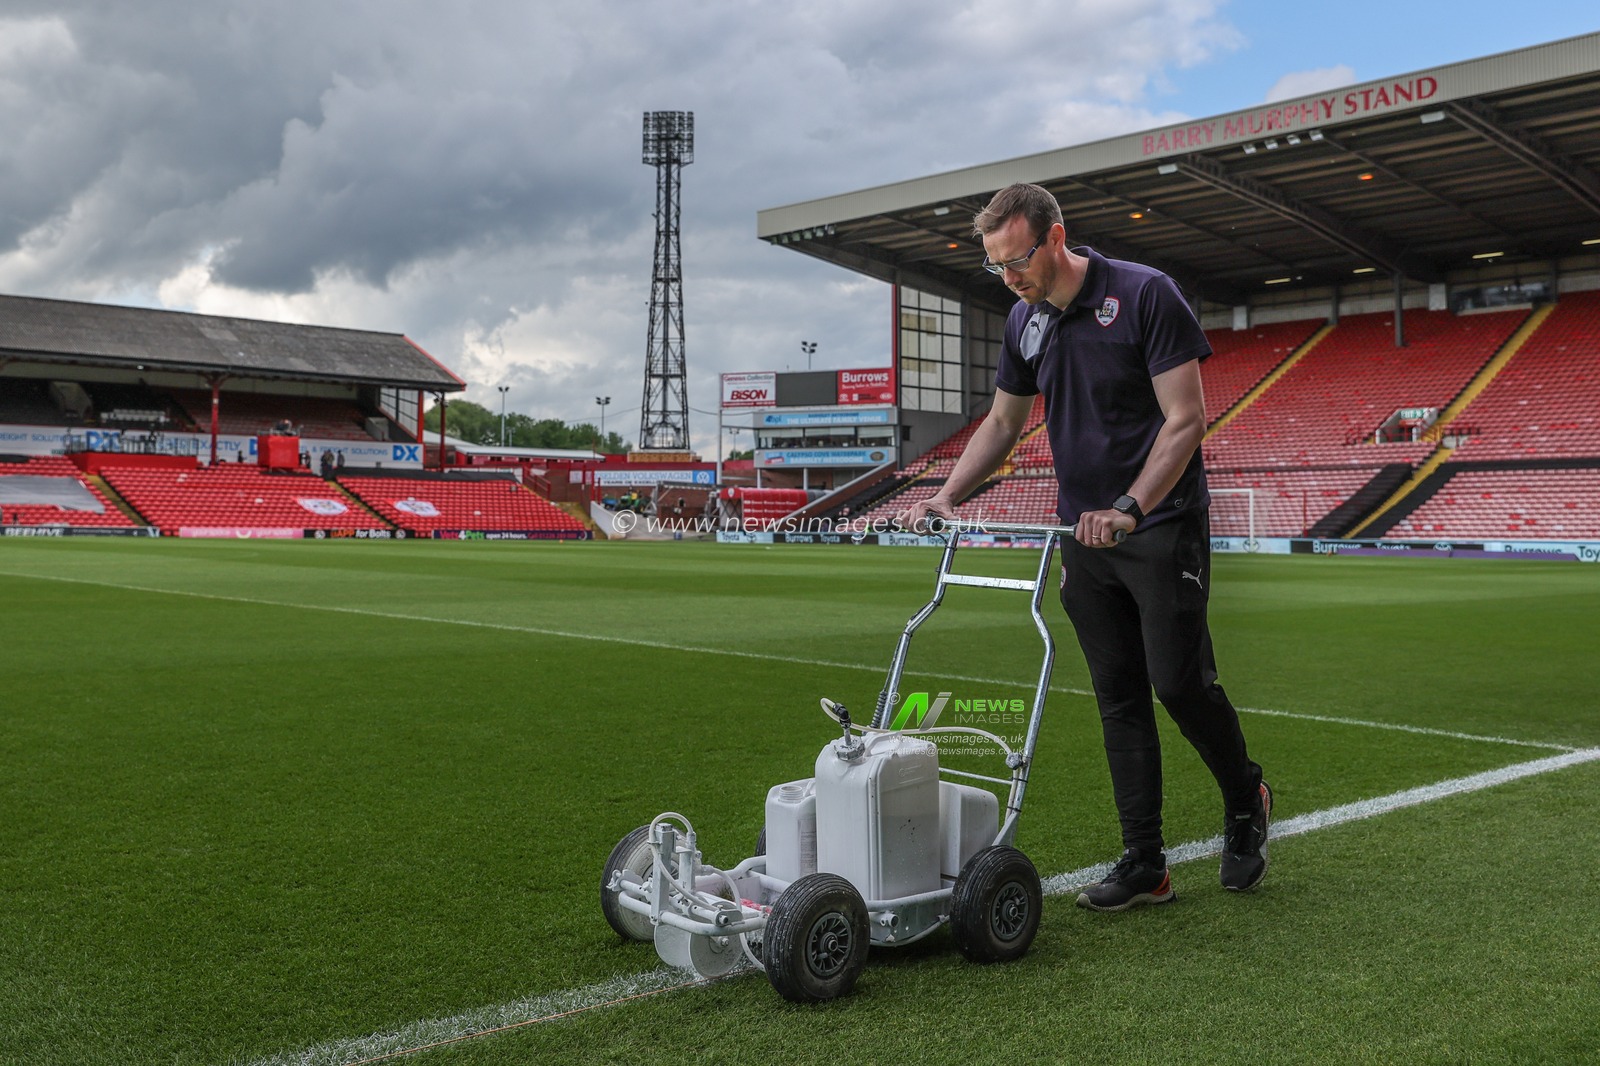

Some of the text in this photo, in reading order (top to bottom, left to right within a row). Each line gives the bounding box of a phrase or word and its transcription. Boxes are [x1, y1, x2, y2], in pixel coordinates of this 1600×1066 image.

[1142, 76, 1438, 156] BARRY MURPHY STAND
[842, 372, 889, 383] Burrows
[351, 447, 388, 456] SOLUTIONS
[392, 445, 419, 462] DX
[632, 472, 692, 480] VOLKSWAGEN
[5, 527, 64, 537] BEEHIVE
[355, 529, 369, 538] for
[369, 529, 391, 538] Bolts
[440, 530, 485, 540] Vets4Pets
[485, 532, 500, 540] open
[722, 532, 740, 541] Toyota
[785, 533, 813, 544] Burrows
[889, 534, 920, 546] Burrows
